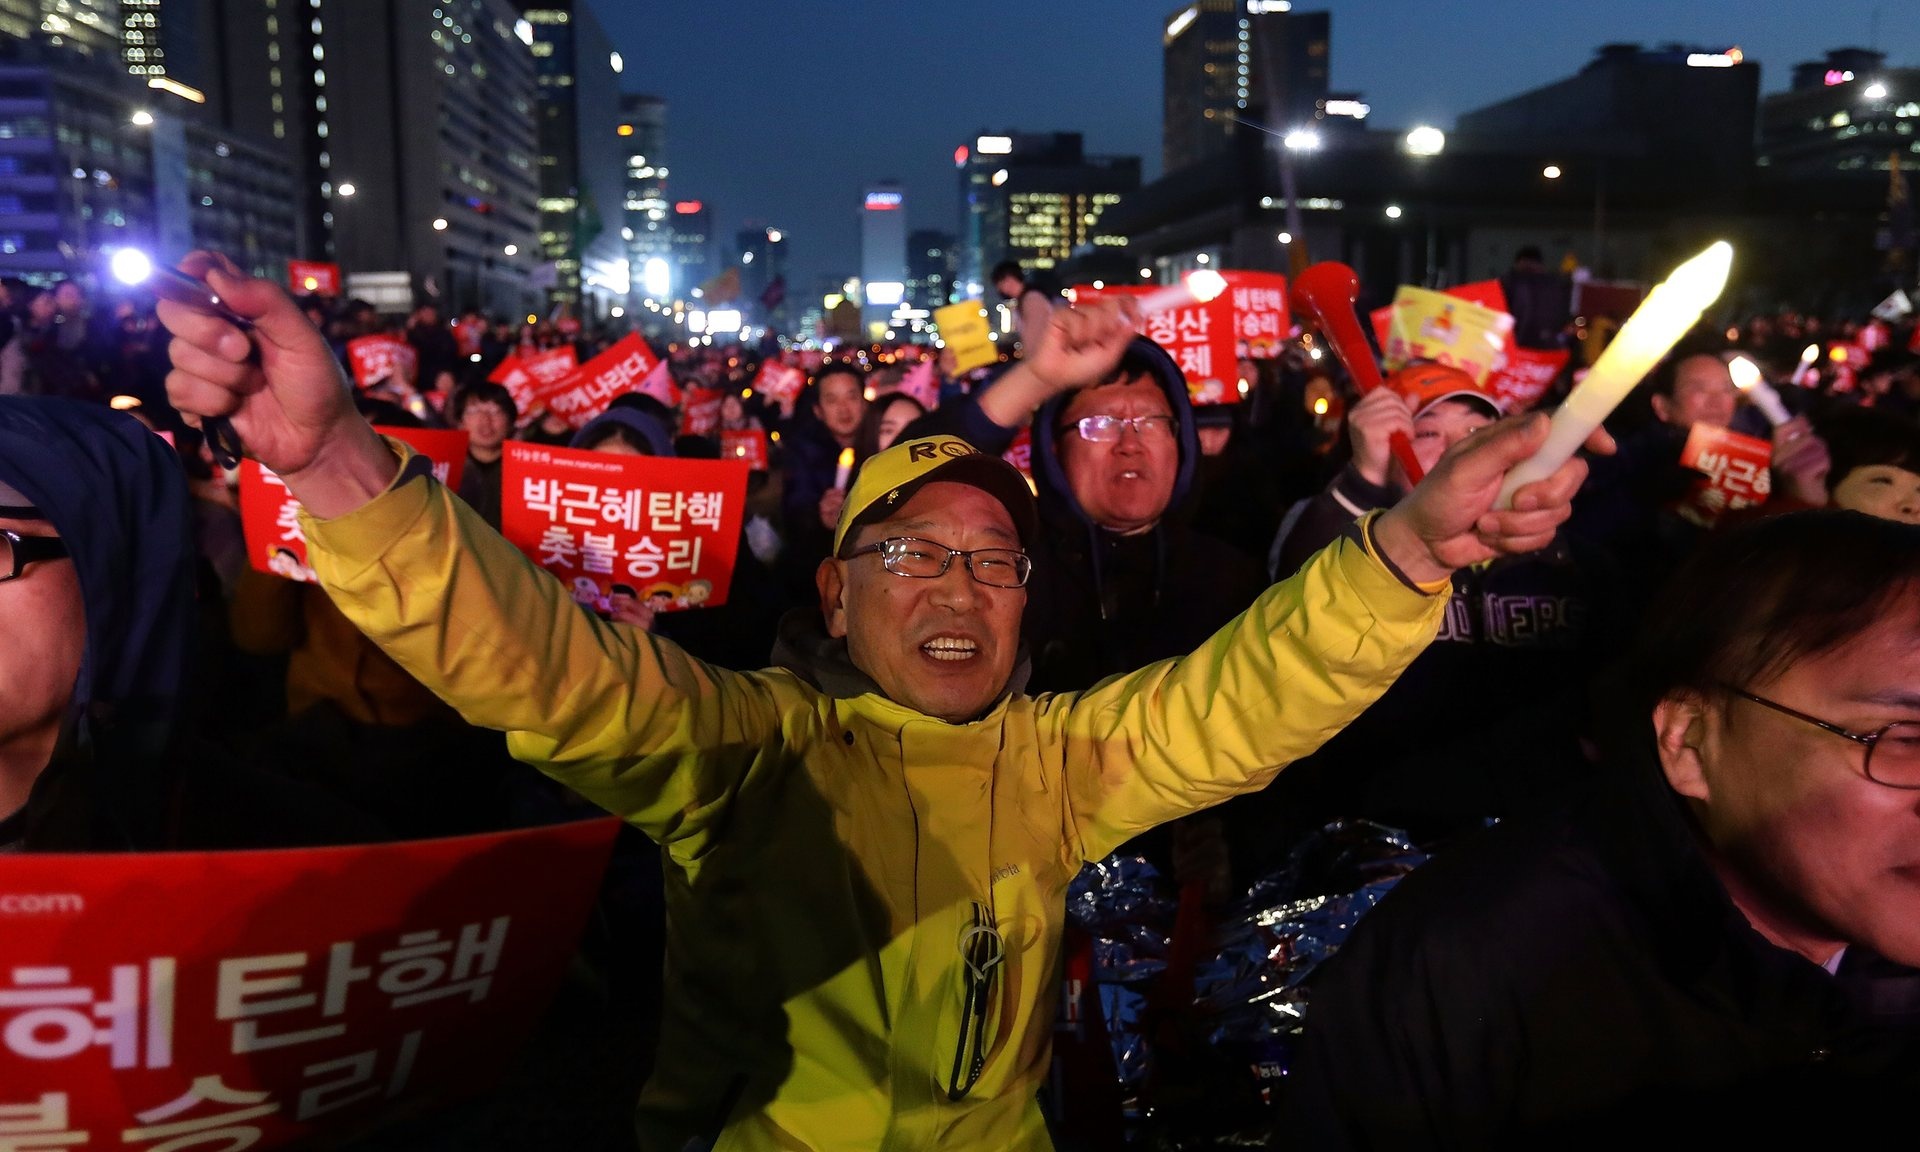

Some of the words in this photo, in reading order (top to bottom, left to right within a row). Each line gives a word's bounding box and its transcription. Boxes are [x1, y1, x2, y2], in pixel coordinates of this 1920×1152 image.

[523, 476, 642, 532] 박근혜
[648, 491, 724, 533] 탄핵
[539, 525, 619, 575] 촛불
[624, 535, 702, 579] 승리
[0, 953, 178, 1071] 혜
[214, 914, 513, 1056] 탄핵
